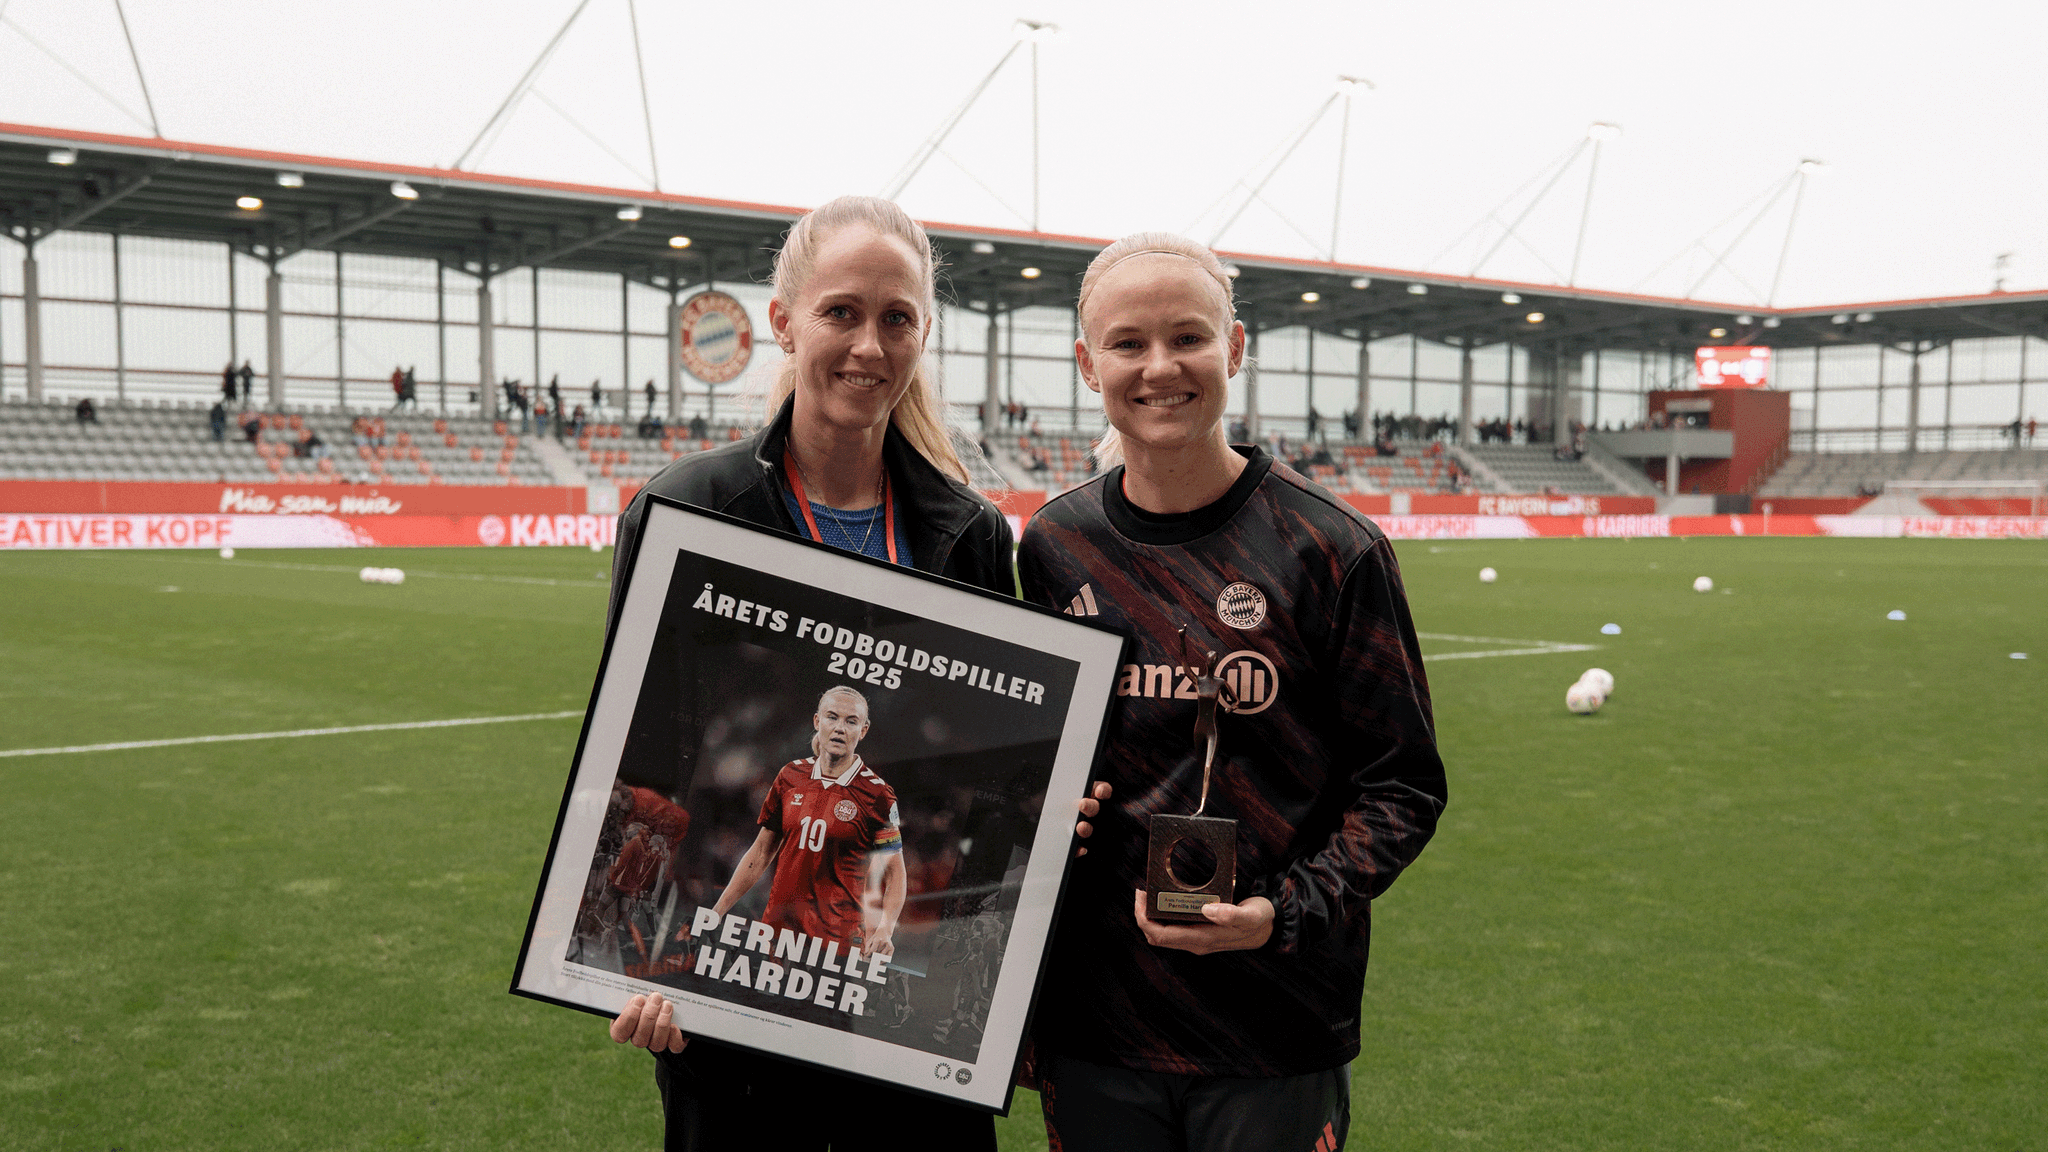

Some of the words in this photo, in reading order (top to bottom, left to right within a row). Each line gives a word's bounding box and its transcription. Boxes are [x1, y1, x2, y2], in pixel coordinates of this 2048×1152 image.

[219, 488, 276, 513] Mia
[276, 494, 338, 515] san
[339, 488, 402, 515] mia
[146, 519, 232, 544] KOPF
[1600, 516, 1669, 536] KARRIERE
[1222, 591, 1232, 602] FC
[1232, 585, 1262, 604] BAYERN
[1221, 609, 1261, 626] MÜNCHEN
[693, 583, 788, 632] ÅRETS
[796, 617, 1046, 705] FODBOLDSPILLER
[827, 652, 903, 690] 2025
[1116, 664, 1200, 700] anz
[799, 816, 827, 852] 10
[690, 906, 893, 985] PERNILLE
[694, 944, 868, 1016] HARDER
